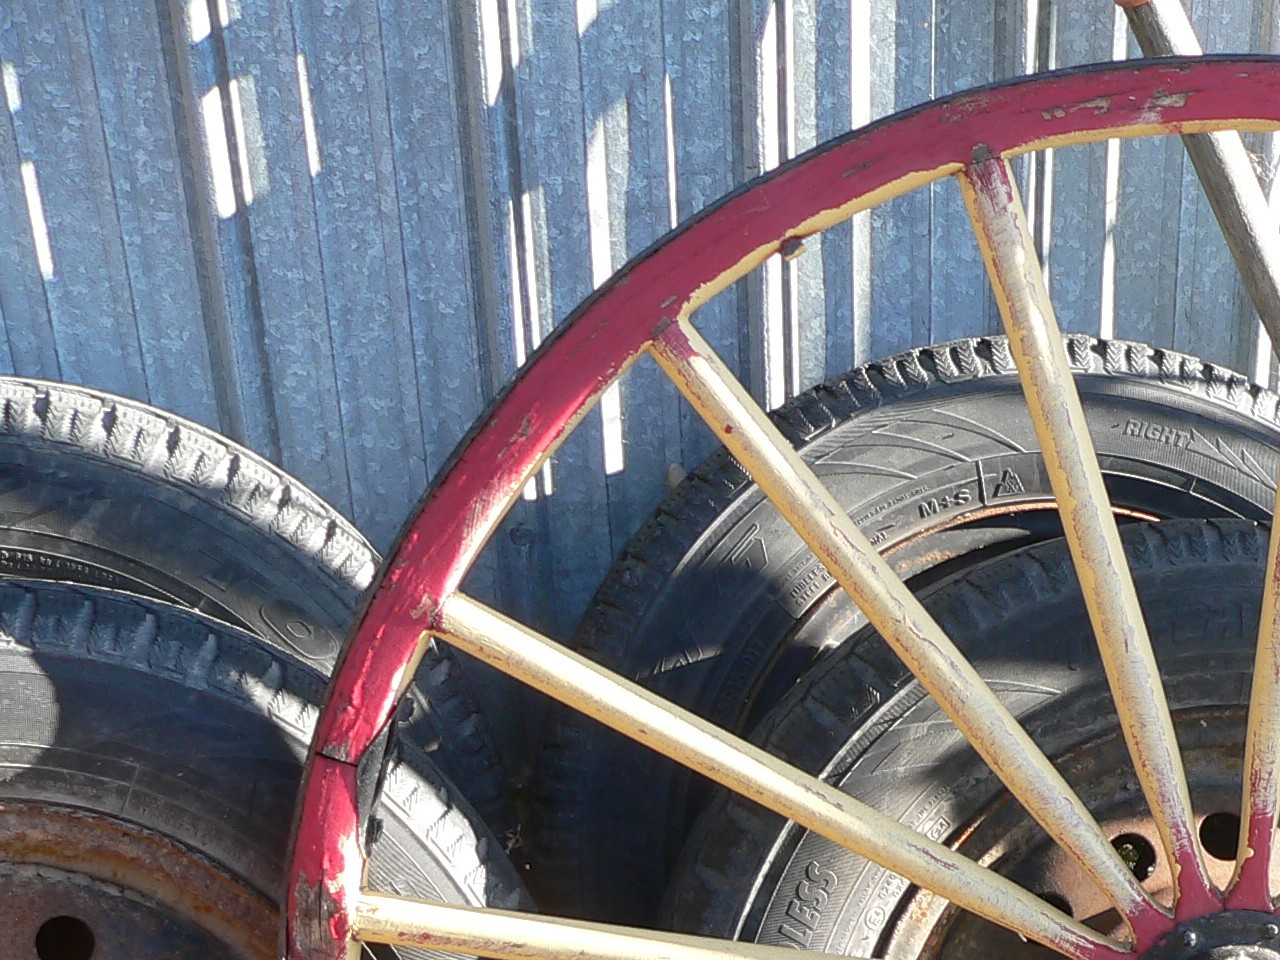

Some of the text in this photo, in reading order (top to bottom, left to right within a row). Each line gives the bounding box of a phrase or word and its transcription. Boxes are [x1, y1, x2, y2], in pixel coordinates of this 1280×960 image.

[1122, 418, 1195, 450] RIGHT
[917, 487, 973, 520] M+S
[790, 564, 826, 599] TUBELES
